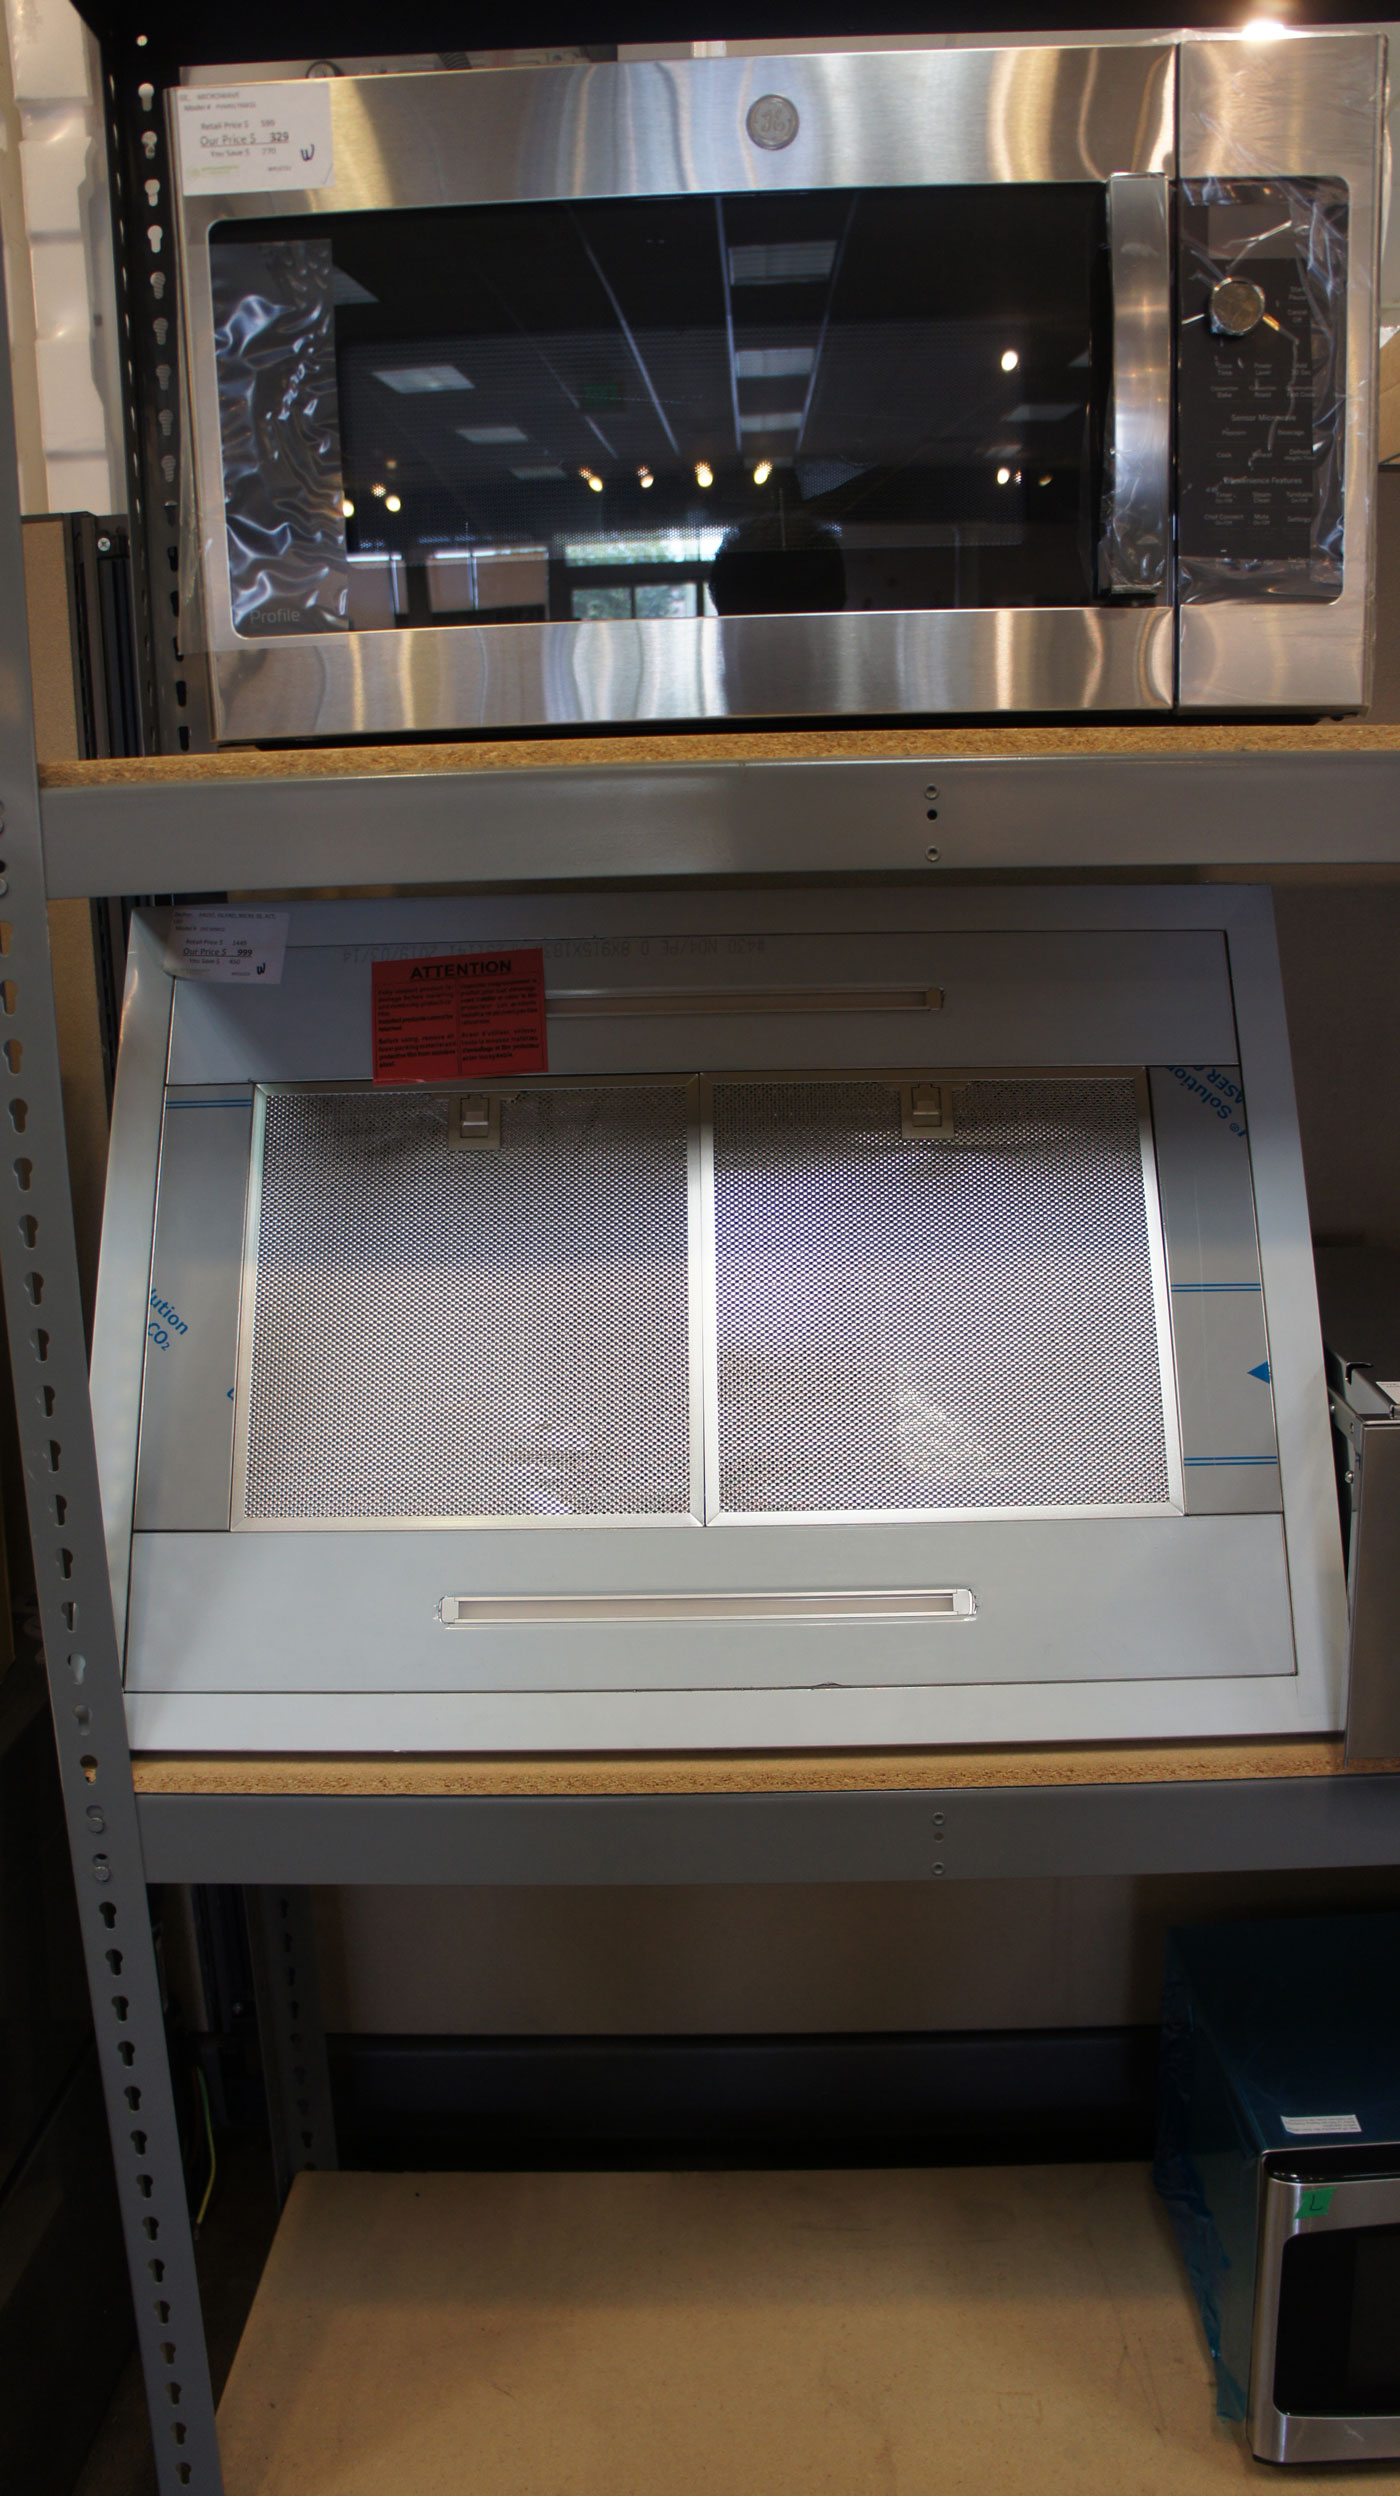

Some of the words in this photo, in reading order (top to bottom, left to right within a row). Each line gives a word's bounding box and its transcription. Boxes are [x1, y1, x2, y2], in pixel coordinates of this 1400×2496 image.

[223, 121, 242, 129] Price
[200, 135, 219, 146] Our
[222, 134, 248, 145] Price
[250, 133, 256, 143] $
[270, 131, 289, 143] 329
[1231, 414, 1257, 422] Sensor
[1271, 476, 1303, 484] Features
[250, 608, 300, 624] Profile
[183, 947, 198, 956] Our
[200, 948, 218, 957] Price
[237, 949, 253, 957] 999
[410, 959, 513, 980] ATTENTION
[1166, 1066, 1232, 1119] Solutio
[1309, 2194, 1323, 2211] L
